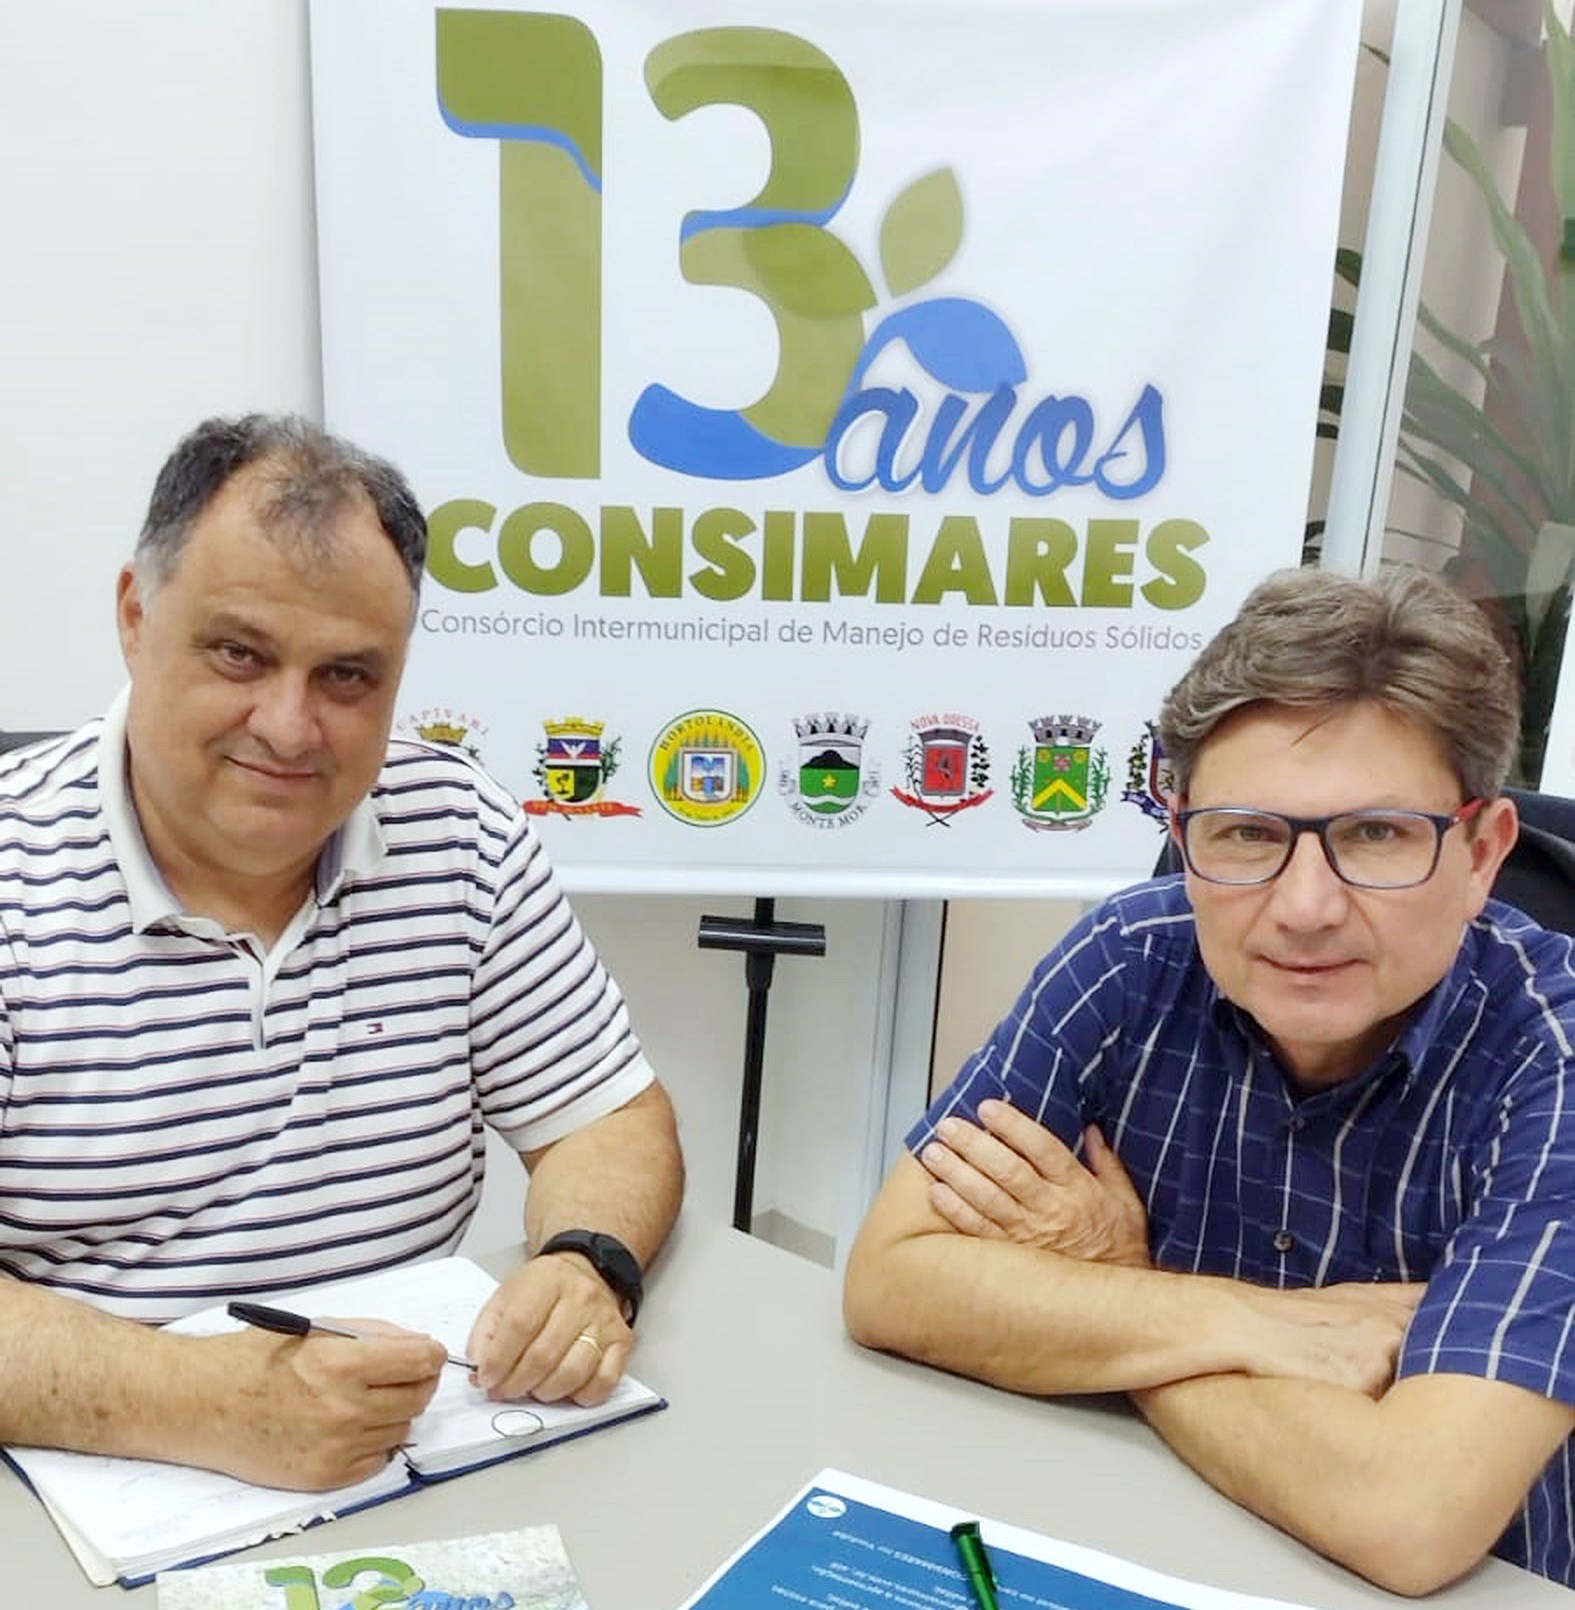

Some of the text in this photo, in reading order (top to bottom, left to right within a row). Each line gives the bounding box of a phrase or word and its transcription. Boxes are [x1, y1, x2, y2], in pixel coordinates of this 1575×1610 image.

[435, 8, 1168, 500] 13 anos
[425, 499, 1212, 611] CONSIMARES
[421, 608, 1203, 651] Consórcio Intermunicipal de Manejo de Resíduos Sólidos
